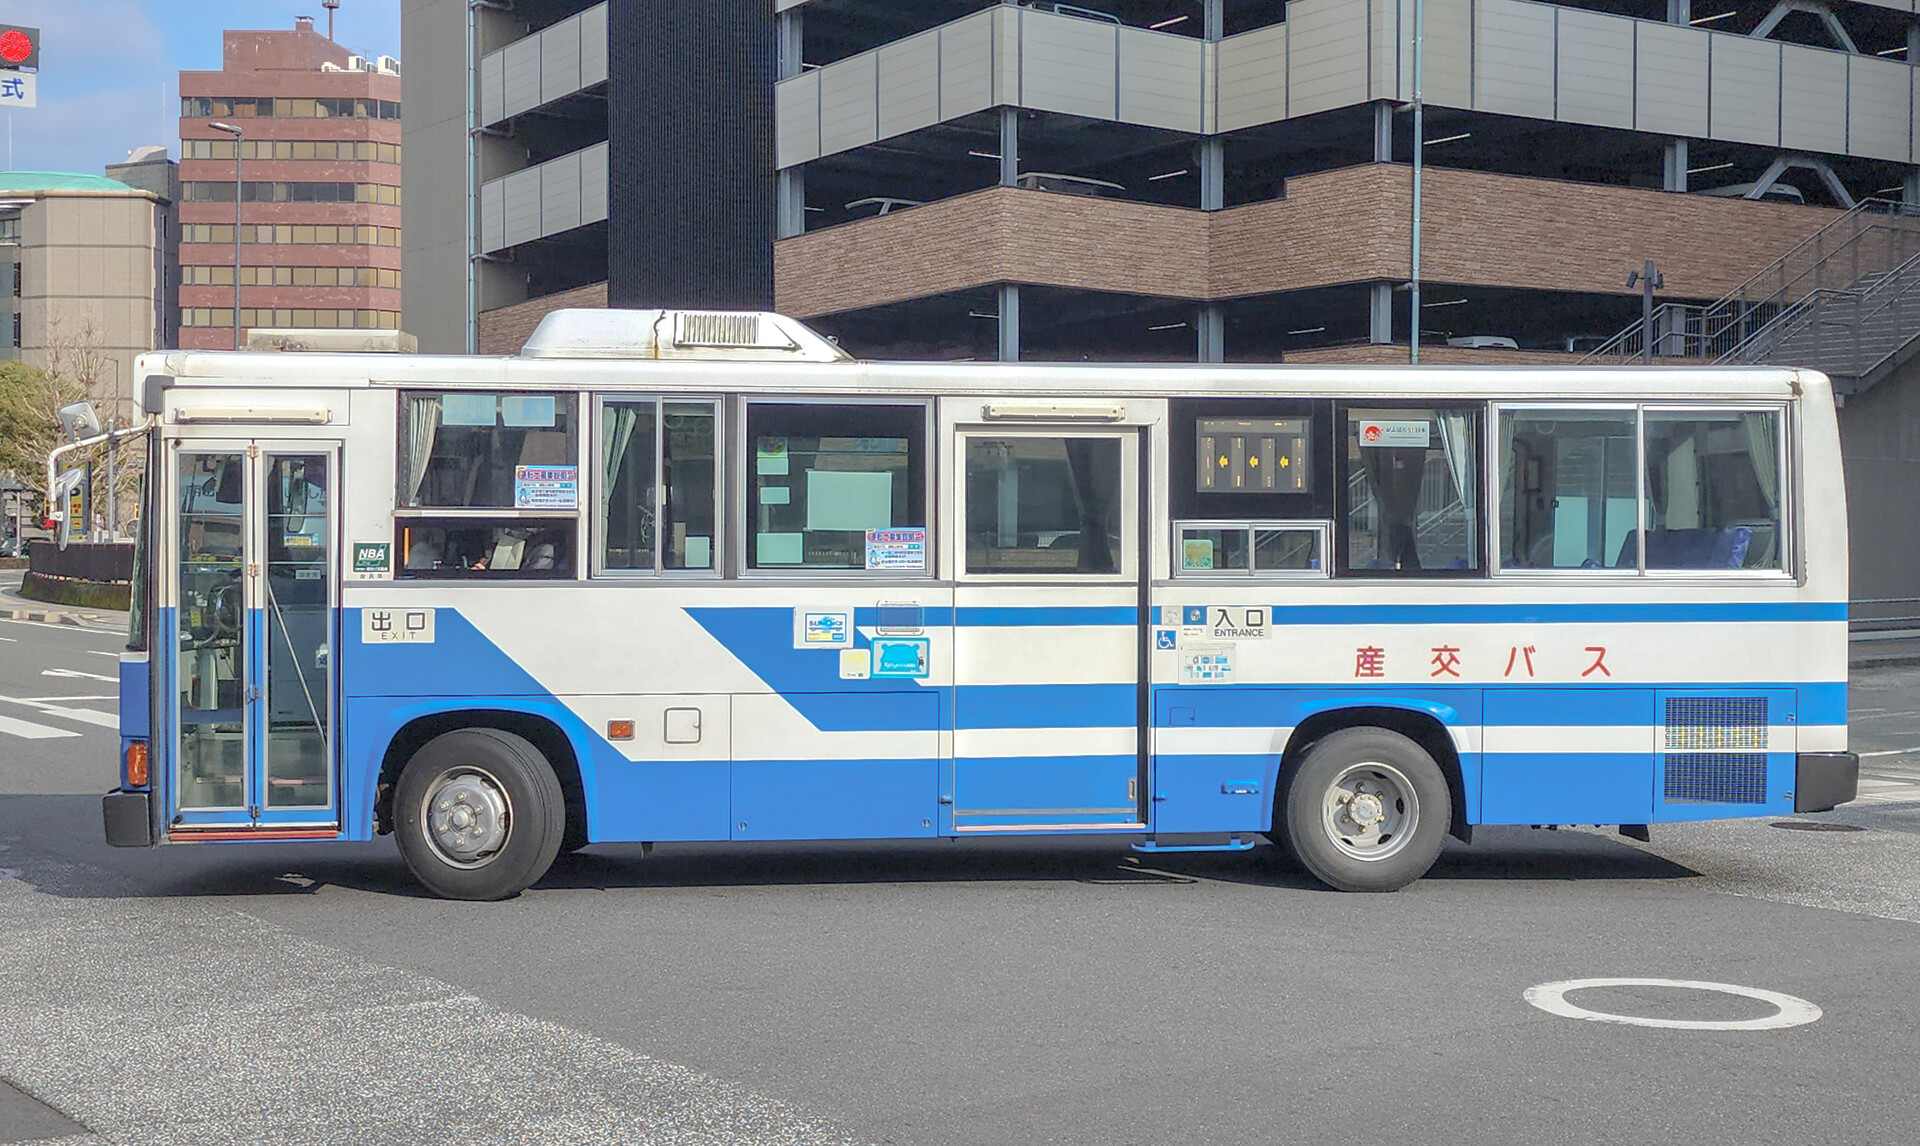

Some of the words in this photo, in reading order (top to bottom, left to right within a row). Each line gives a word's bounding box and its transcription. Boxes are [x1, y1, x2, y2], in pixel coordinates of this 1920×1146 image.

[1, 78, 24, 100] 式
[358, 548, 385, 560] NBA
[371, 611, 426, 631] 出口
[1215, 609, 1264, 628] 入口
[381, 632, 417, 640] EXIT
[1214, 628, 1264, 637] ENTRANCE
[1355, 645, 1612, 678] 産交バス
